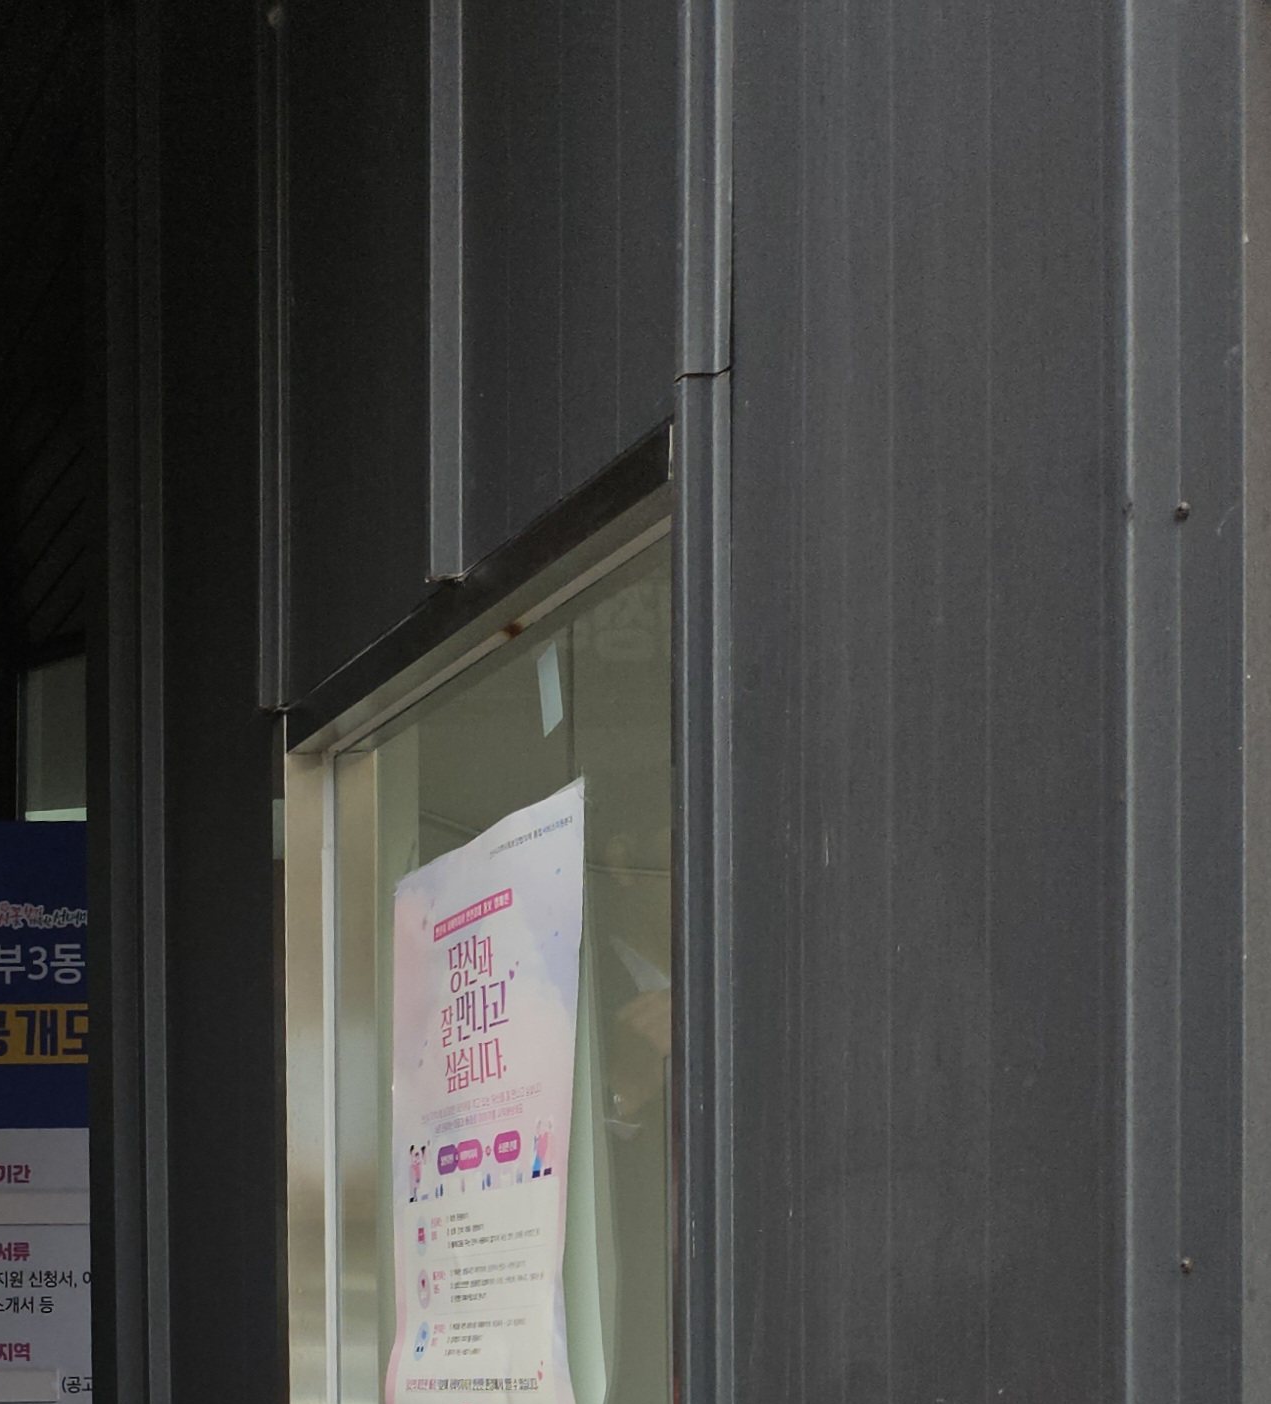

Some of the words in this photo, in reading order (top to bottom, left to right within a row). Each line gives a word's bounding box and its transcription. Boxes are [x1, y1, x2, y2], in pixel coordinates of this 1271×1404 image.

[447, 934, 494, 994] 당신과
[440, 1006, 454, 1048] 잘
[455, 980, 509, 1042] 만나고
[445, 1037, 508, 1095] 싶습니다.
[28, 1270, 77, 1289] 신청서,
[39, 1296, 55, 1314] 등
